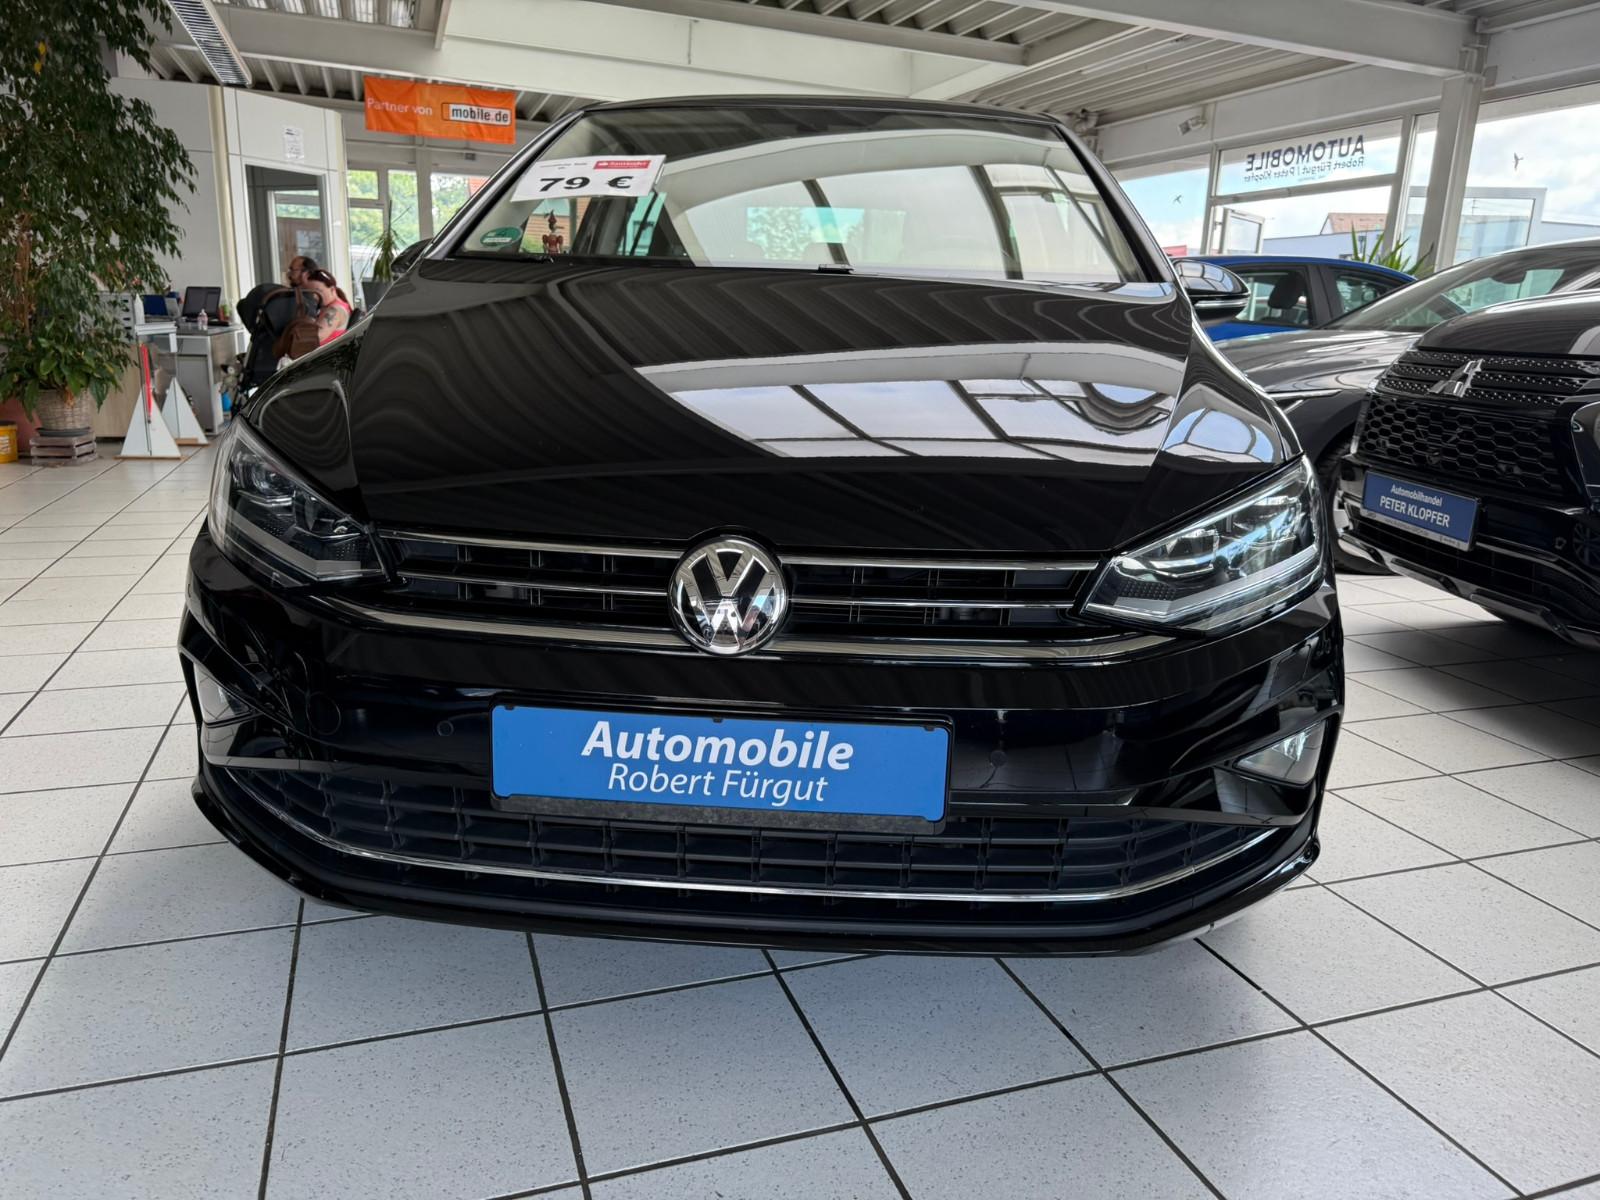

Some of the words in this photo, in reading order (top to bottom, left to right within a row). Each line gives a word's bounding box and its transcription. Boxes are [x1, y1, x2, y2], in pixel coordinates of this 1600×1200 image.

[366, 97, 409, 113] Partner
[412, 104, 433, 116] von
[451, 106, 509, 123] mobile.de
[539, 176, 591, 192] 79
[606, 175, 634, 189] €
[1390, 484, 1443, 506] Automobilhandel
[1379, 495, 1406, 514] PETER
[1407, 503, 1451, 528] KLOPFER
[581, 720, 854, 770] Automobile
[608, 763, 715, 797] Robert
[721, 769, 828, 807] Fürgut
